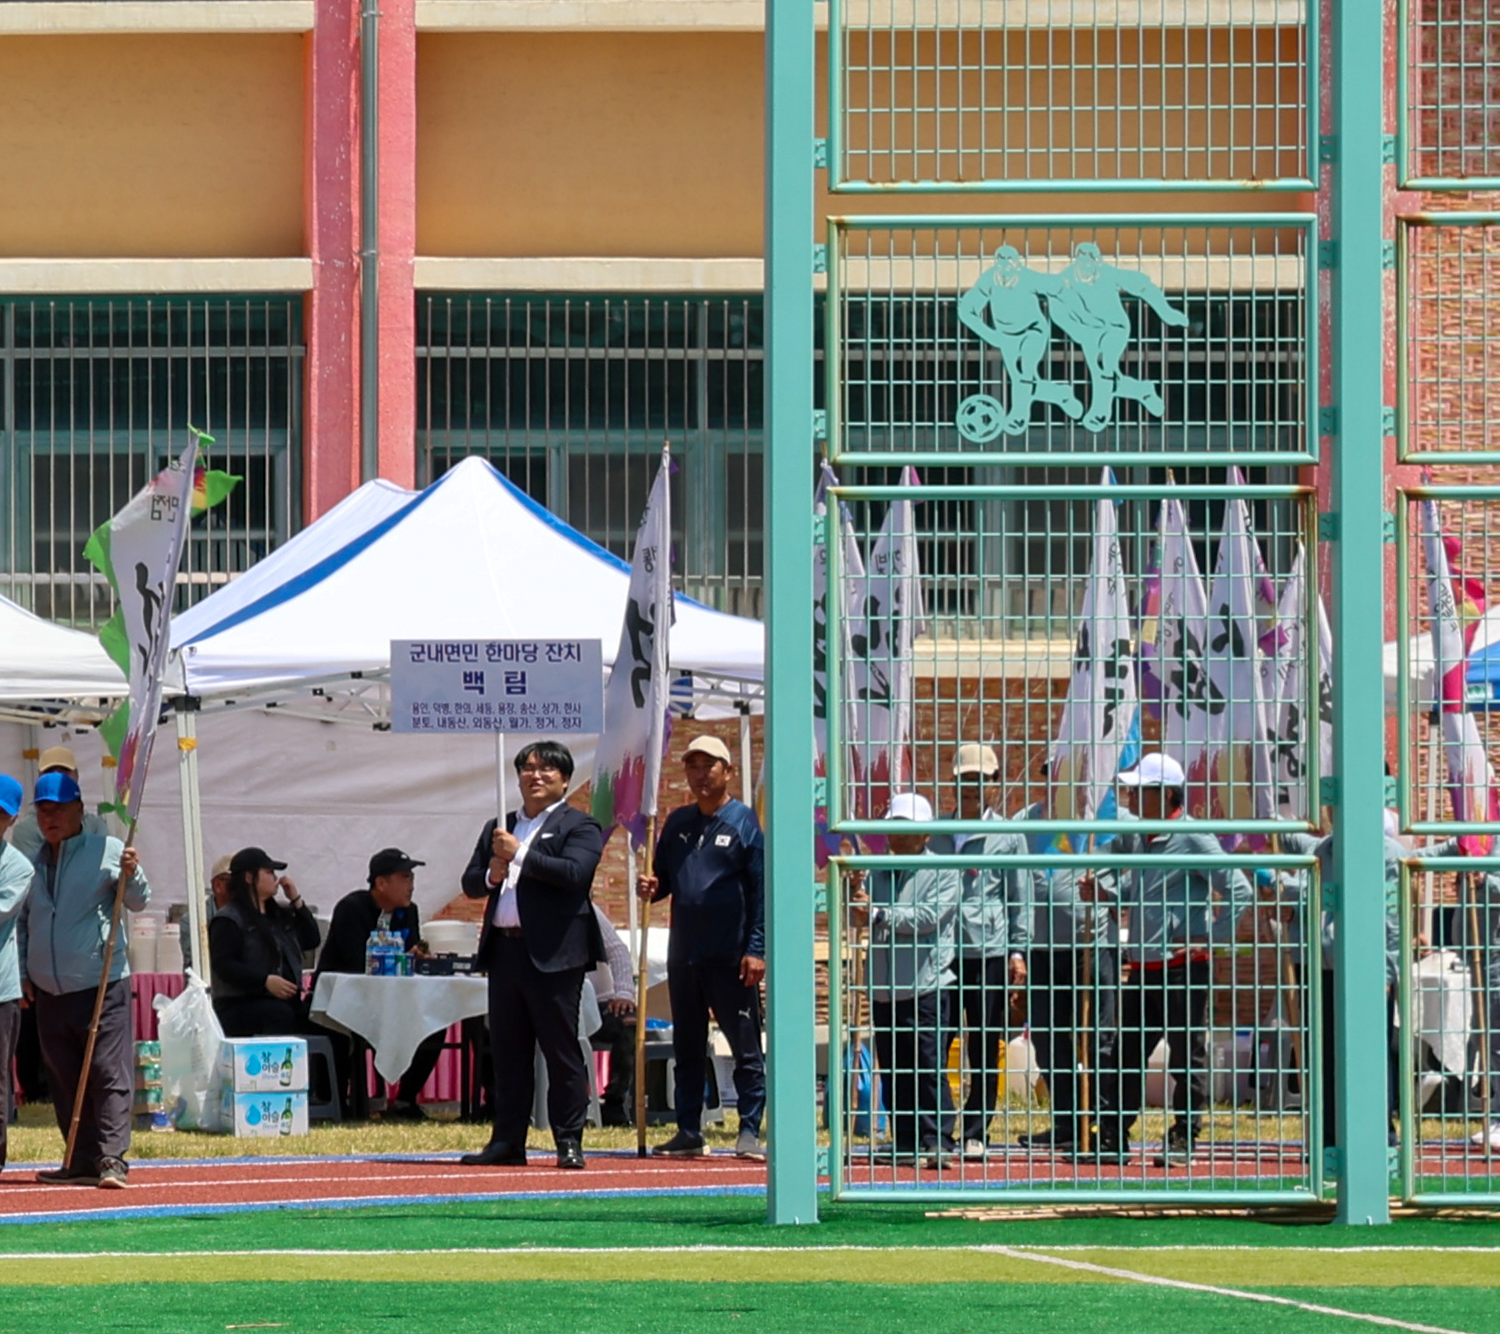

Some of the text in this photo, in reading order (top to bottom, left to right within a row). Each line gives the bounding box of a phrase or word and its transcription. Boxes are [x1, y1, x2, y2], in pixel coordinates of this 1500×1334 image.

[409, 641, 582, 663] 군내면민 한마당 잔치
[462, 670, 527, 695] 백 팀
